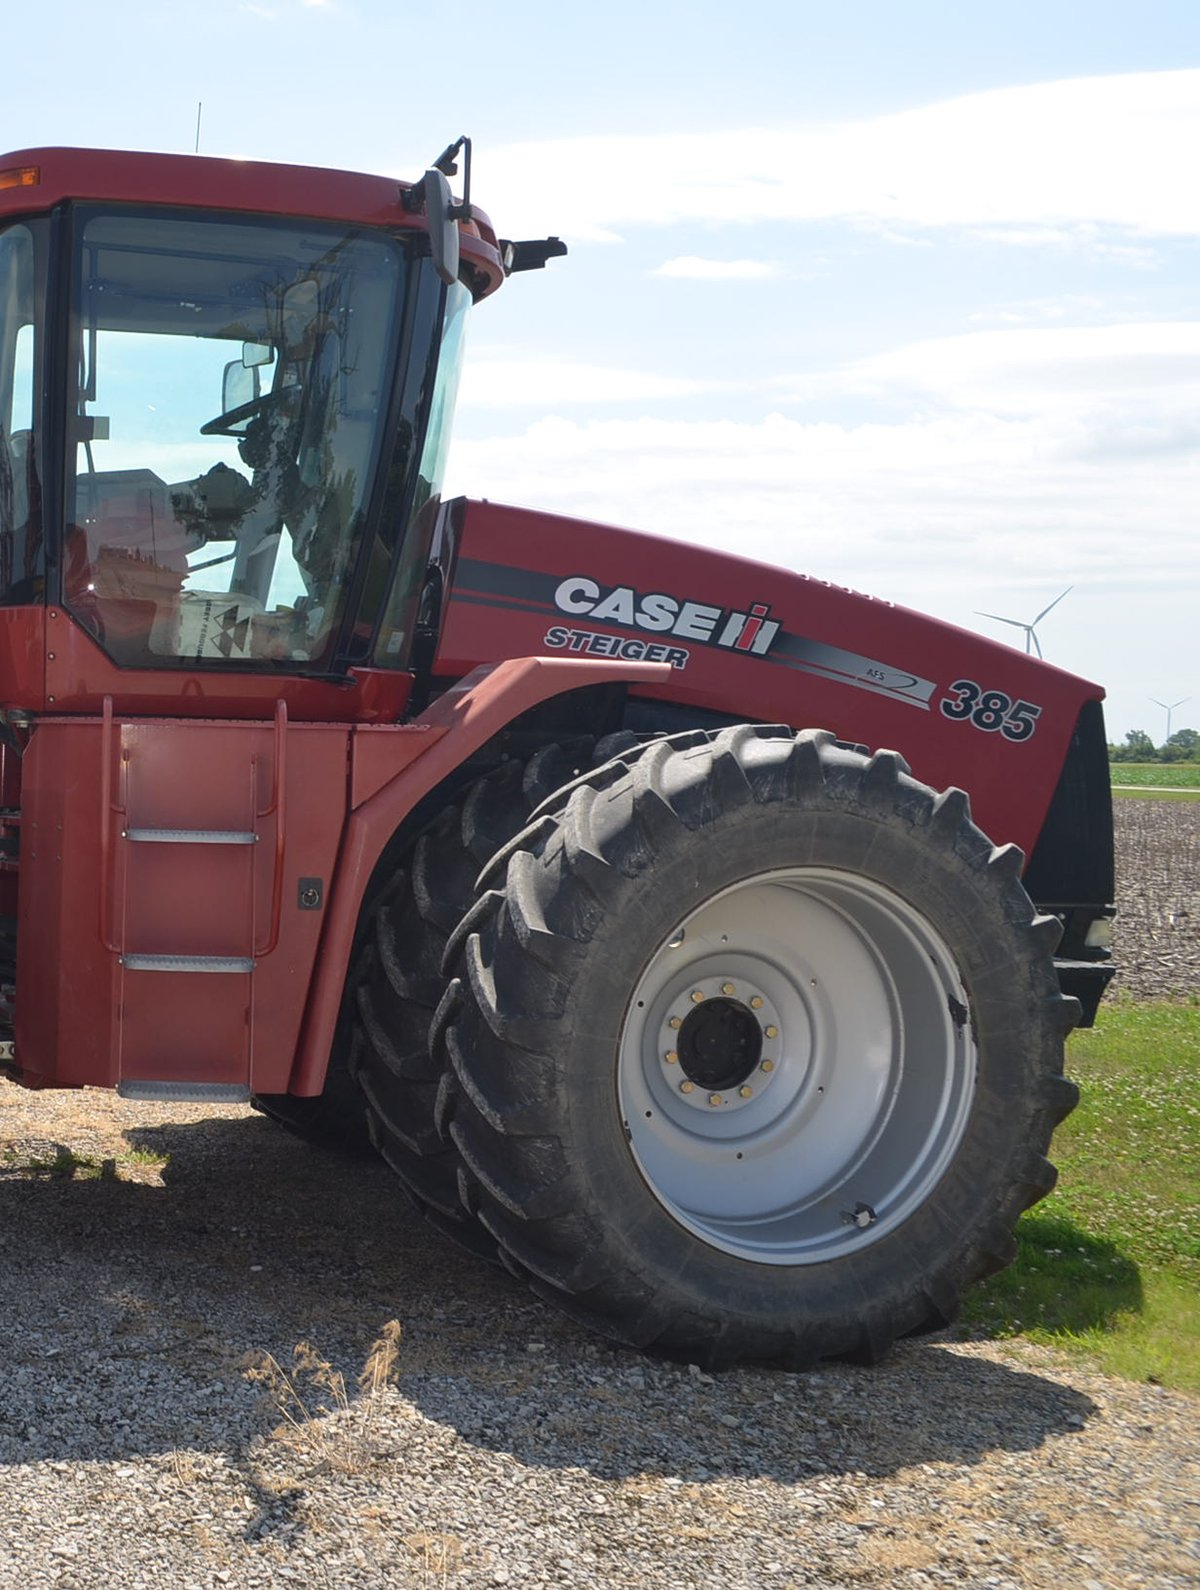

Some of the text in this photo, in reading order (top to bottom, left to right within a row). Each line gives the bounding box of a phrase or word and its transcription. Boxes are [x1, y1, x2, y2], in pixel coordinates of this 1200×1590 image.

[555, 577, 723, 642] CASE
[544, 626, 689, 670] STEIGER
[866, 668, 886, 681] AFS
[939, 679, 1043, 743] 385
